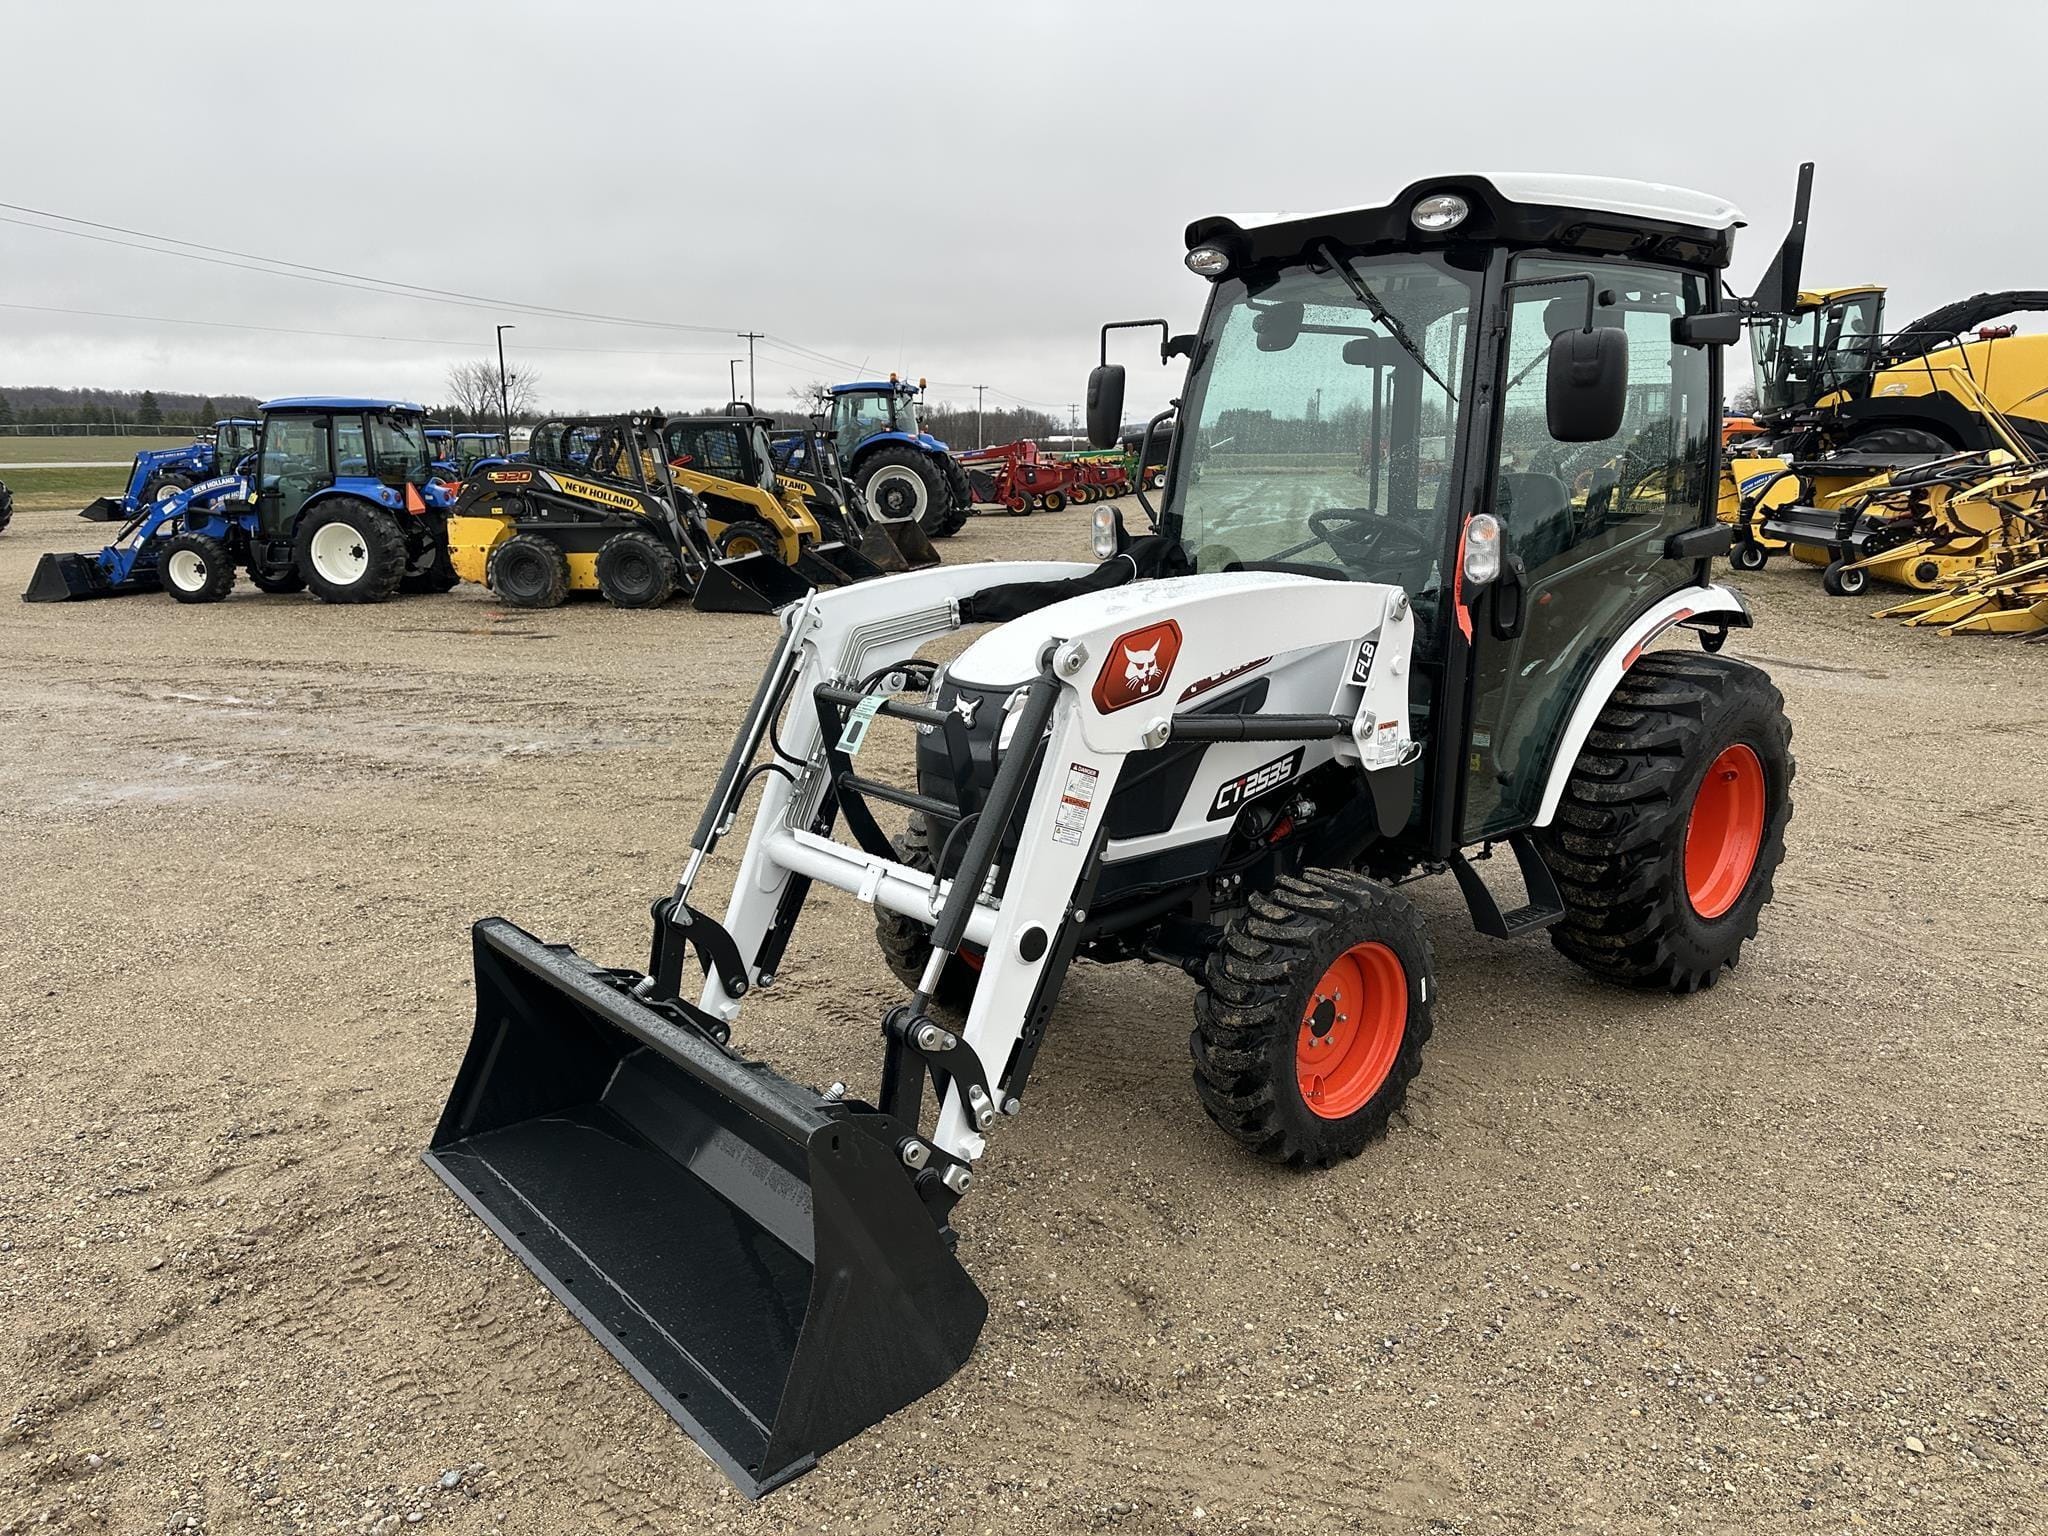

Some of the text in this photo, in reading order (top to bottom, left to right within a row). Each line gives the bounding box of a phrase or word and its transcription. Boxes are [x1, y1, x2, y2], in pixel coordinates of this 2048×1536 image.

[192, 477, 235, 494] NEW HOLLAND
[565, 481, 634, 507] NEW HOLLAND
[776, 478, 807, 491] OLLAND
[1356, 642, 1375, 680] FL8
[1216, 754, 1294, 810] CT2535
